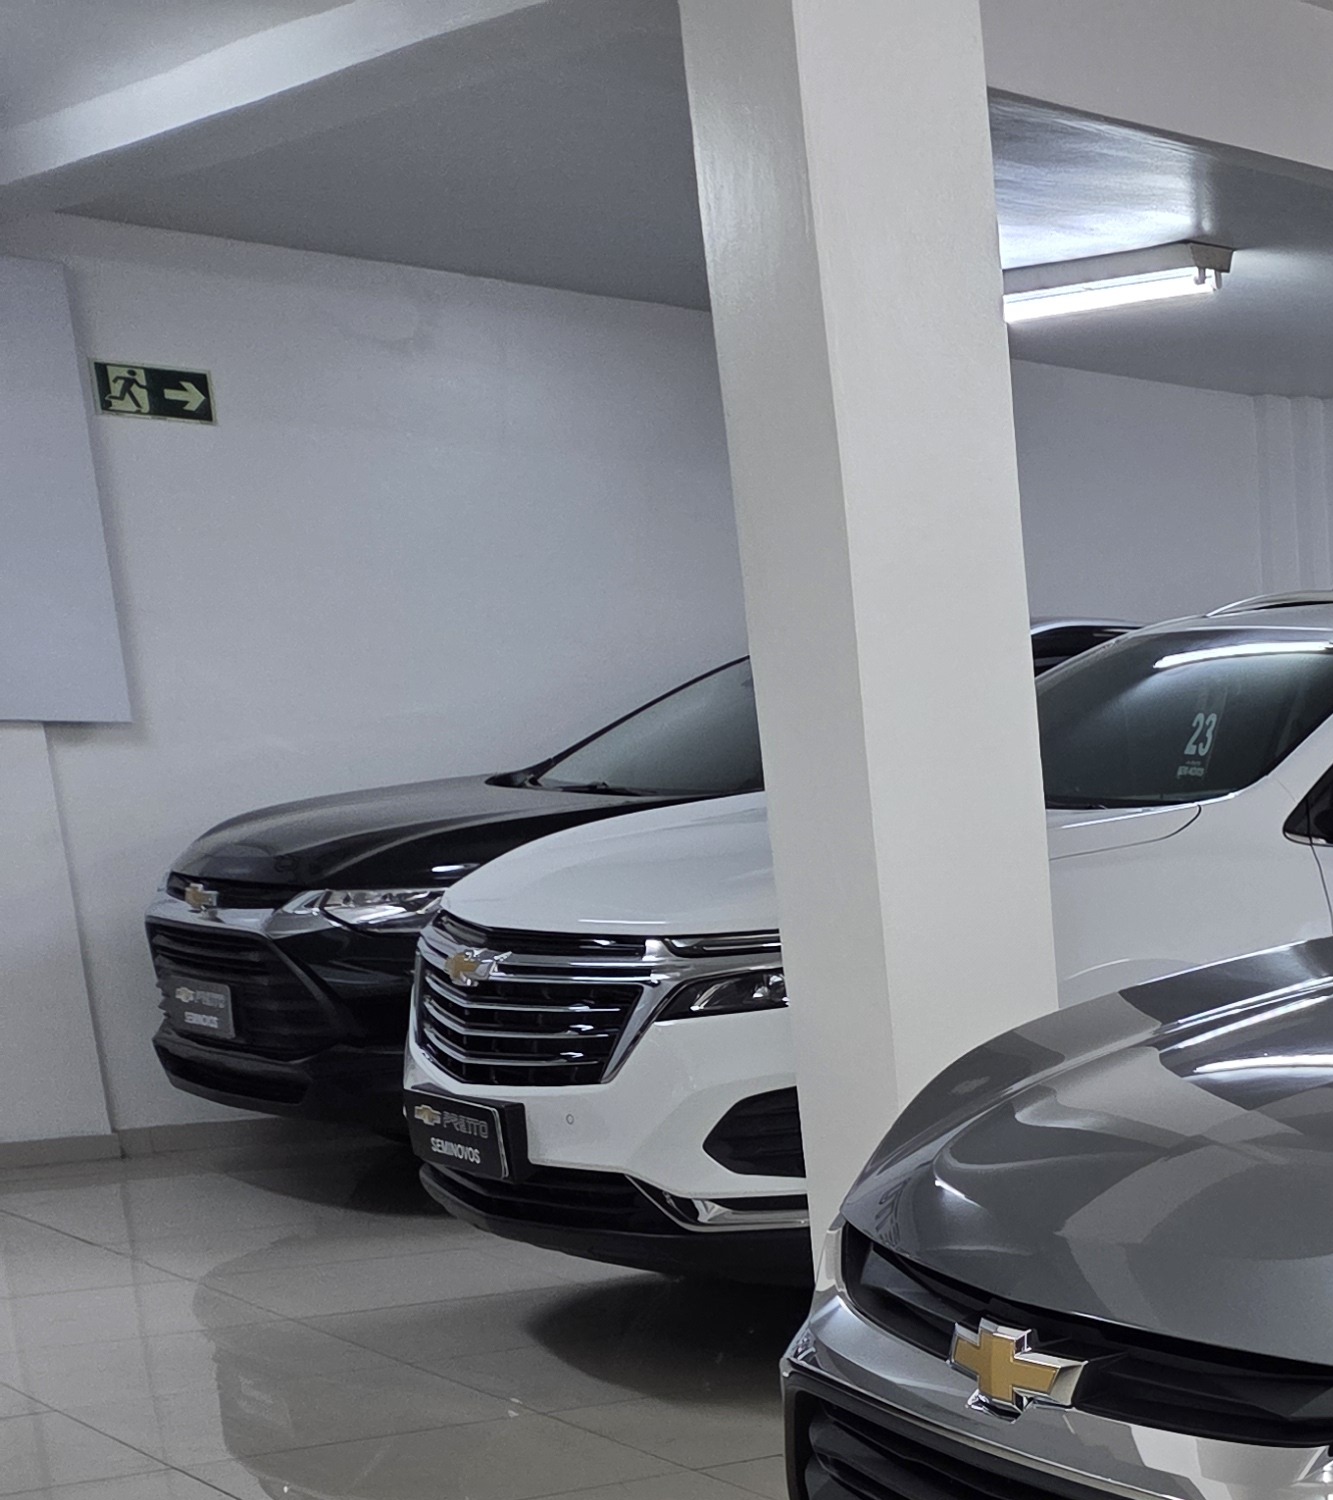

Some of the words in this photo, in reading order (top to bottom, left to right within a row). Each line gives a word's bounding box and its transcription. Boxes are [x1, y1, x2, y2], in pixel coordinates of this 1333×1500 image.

[1183, 712, 1217, 757] 23
[443, 1111, 489, 1139] PRETTO
[430, 1136, 481, 1165] SEMINOVOS
